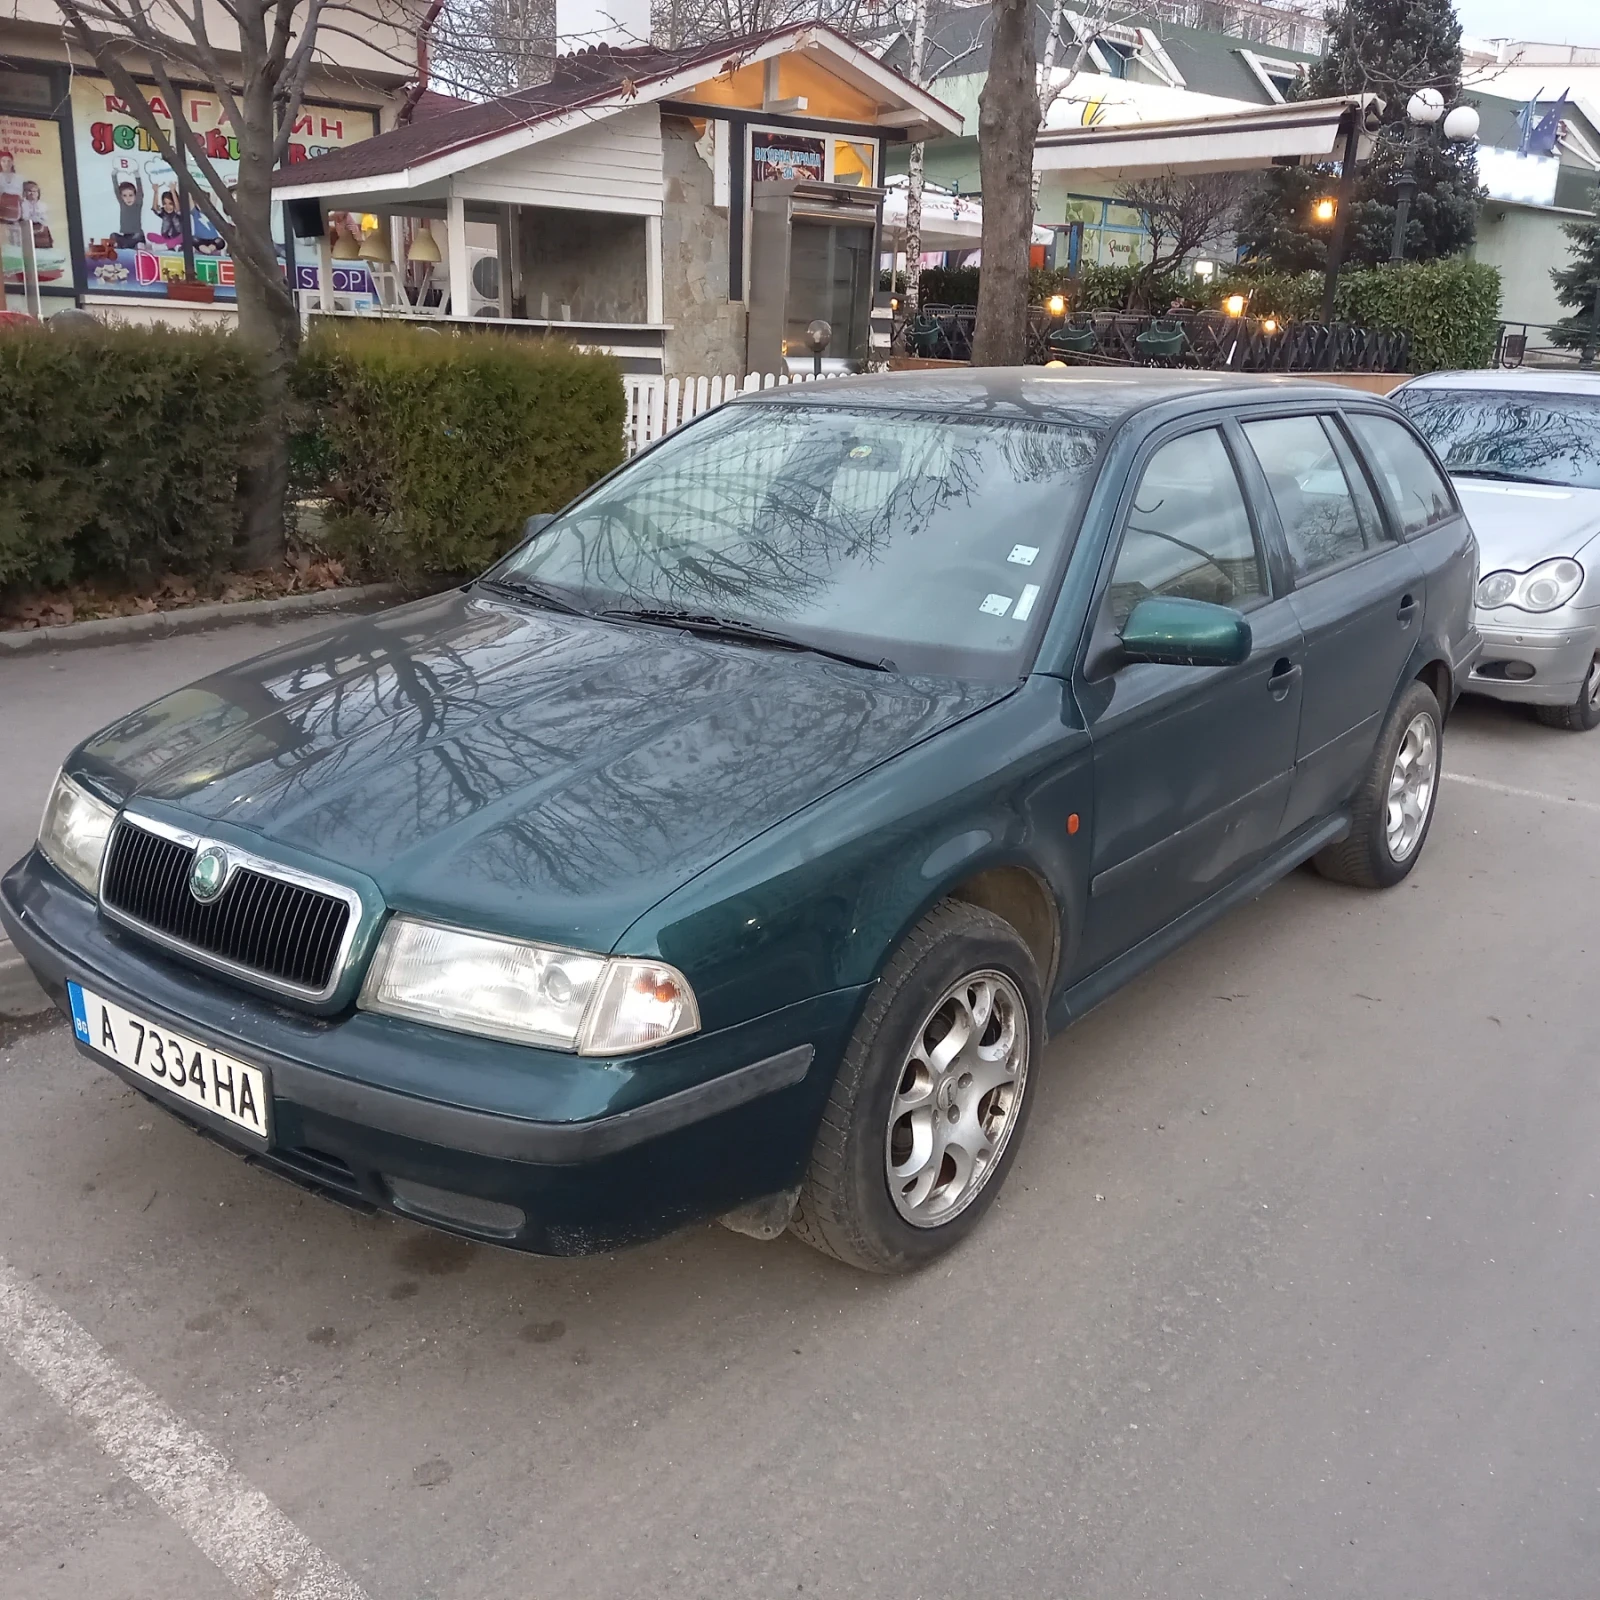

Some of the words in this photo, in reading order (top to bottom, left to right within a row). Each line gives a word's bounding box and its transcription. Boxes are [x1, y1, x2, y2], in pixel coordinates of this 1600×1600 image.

[755, 147, 790, 163] ВКУСНА
[792, 151, 821, 168] ХРАНА
[782, 167, 793, 180] ЗА
[75, 1017, 88, 1035] BG
